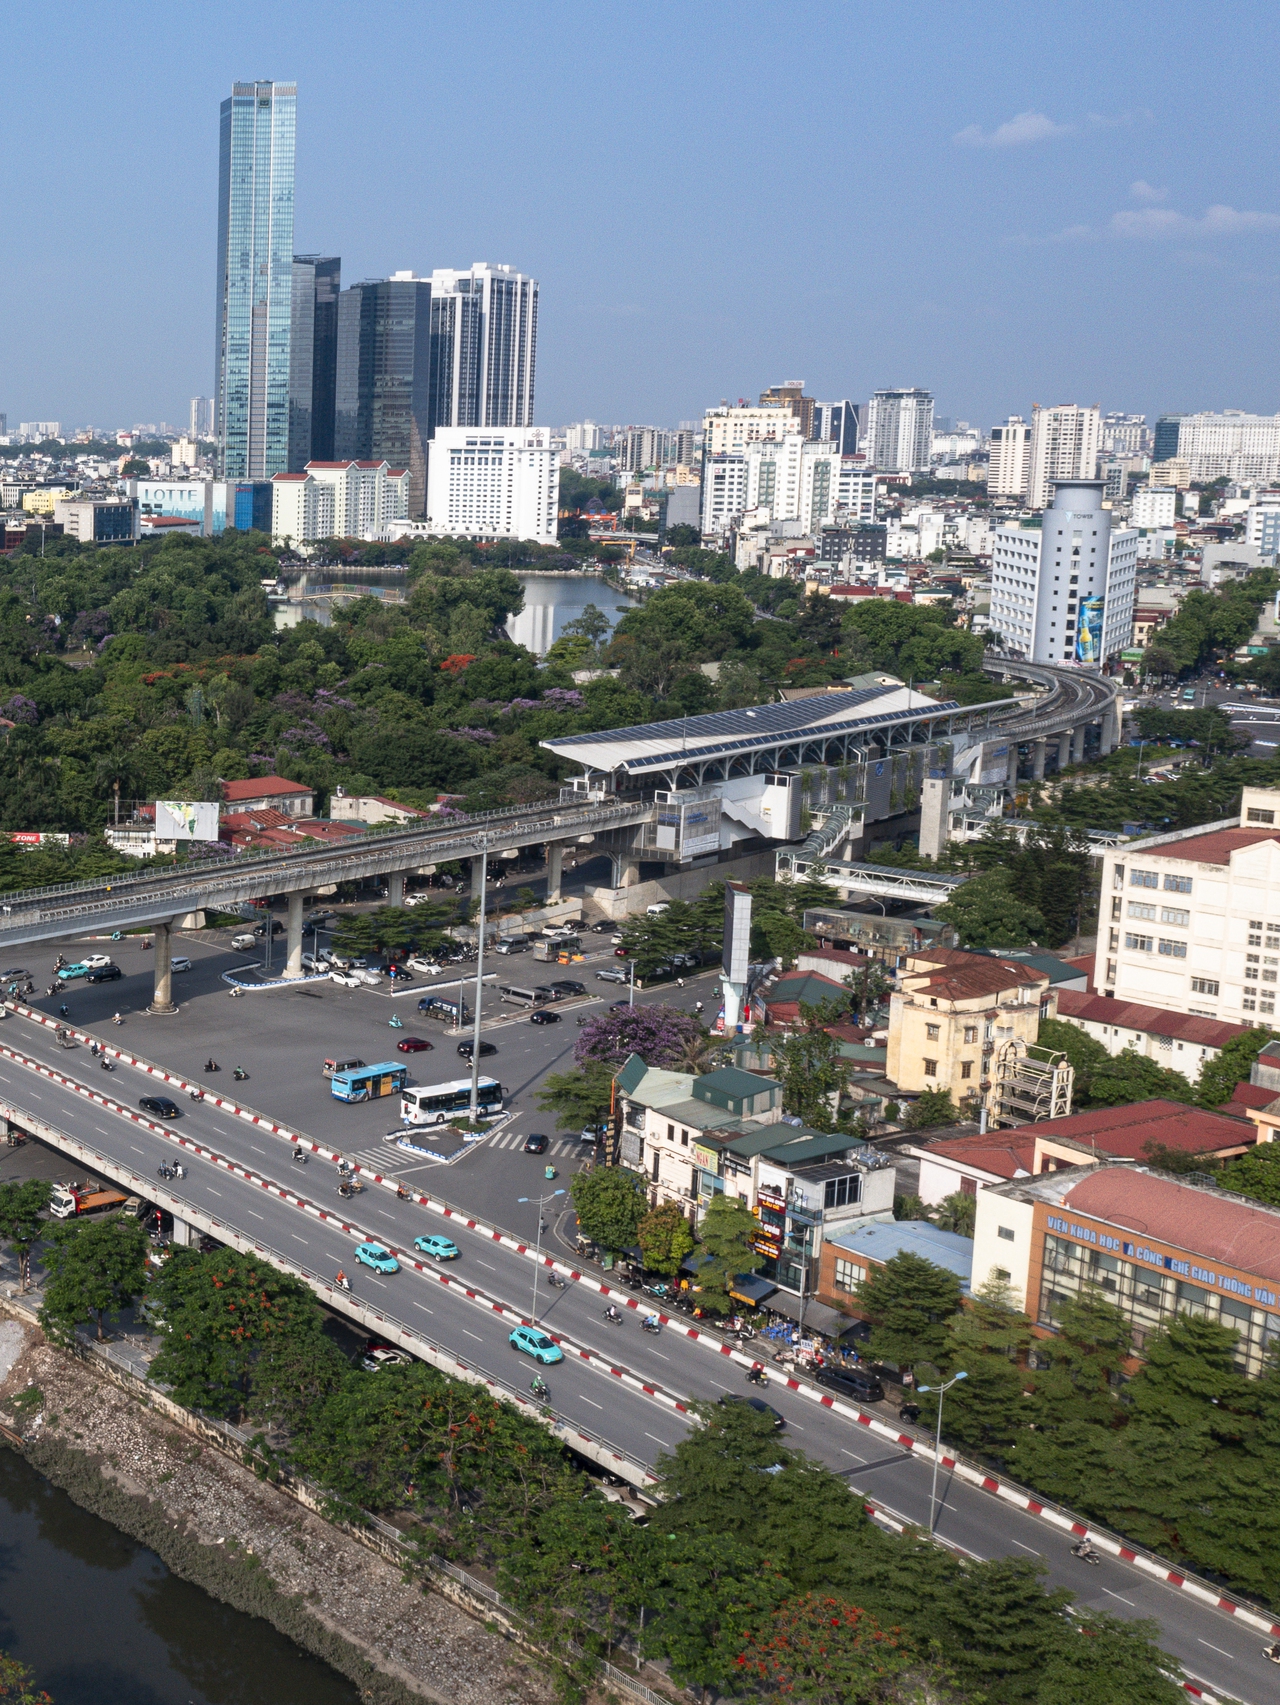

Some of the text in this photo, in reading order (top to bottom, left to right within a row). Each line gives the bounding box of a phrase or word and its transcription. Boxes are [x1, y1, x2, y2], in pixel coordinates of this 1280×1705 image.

[145, 488, 198, 502] LOTTE
[1047, 1215, 1069, 1234] VIỆN
[1070, 1224, 1097, 1244] KHOA
[1099, 1234, 1120, 1252] HỌC
[1122, 1240, 1134, 1257] VÀ
[1136, 1245, 1163, 1267] CÔNG
[1163, 1255, 1191, 1278] NGHỆ
[1191, 1266, 1216, 1285] GIAO
[1218, 1273, 1252, 1298] THÔNG
[1254, 1286, 1276, 1307] VẬN
